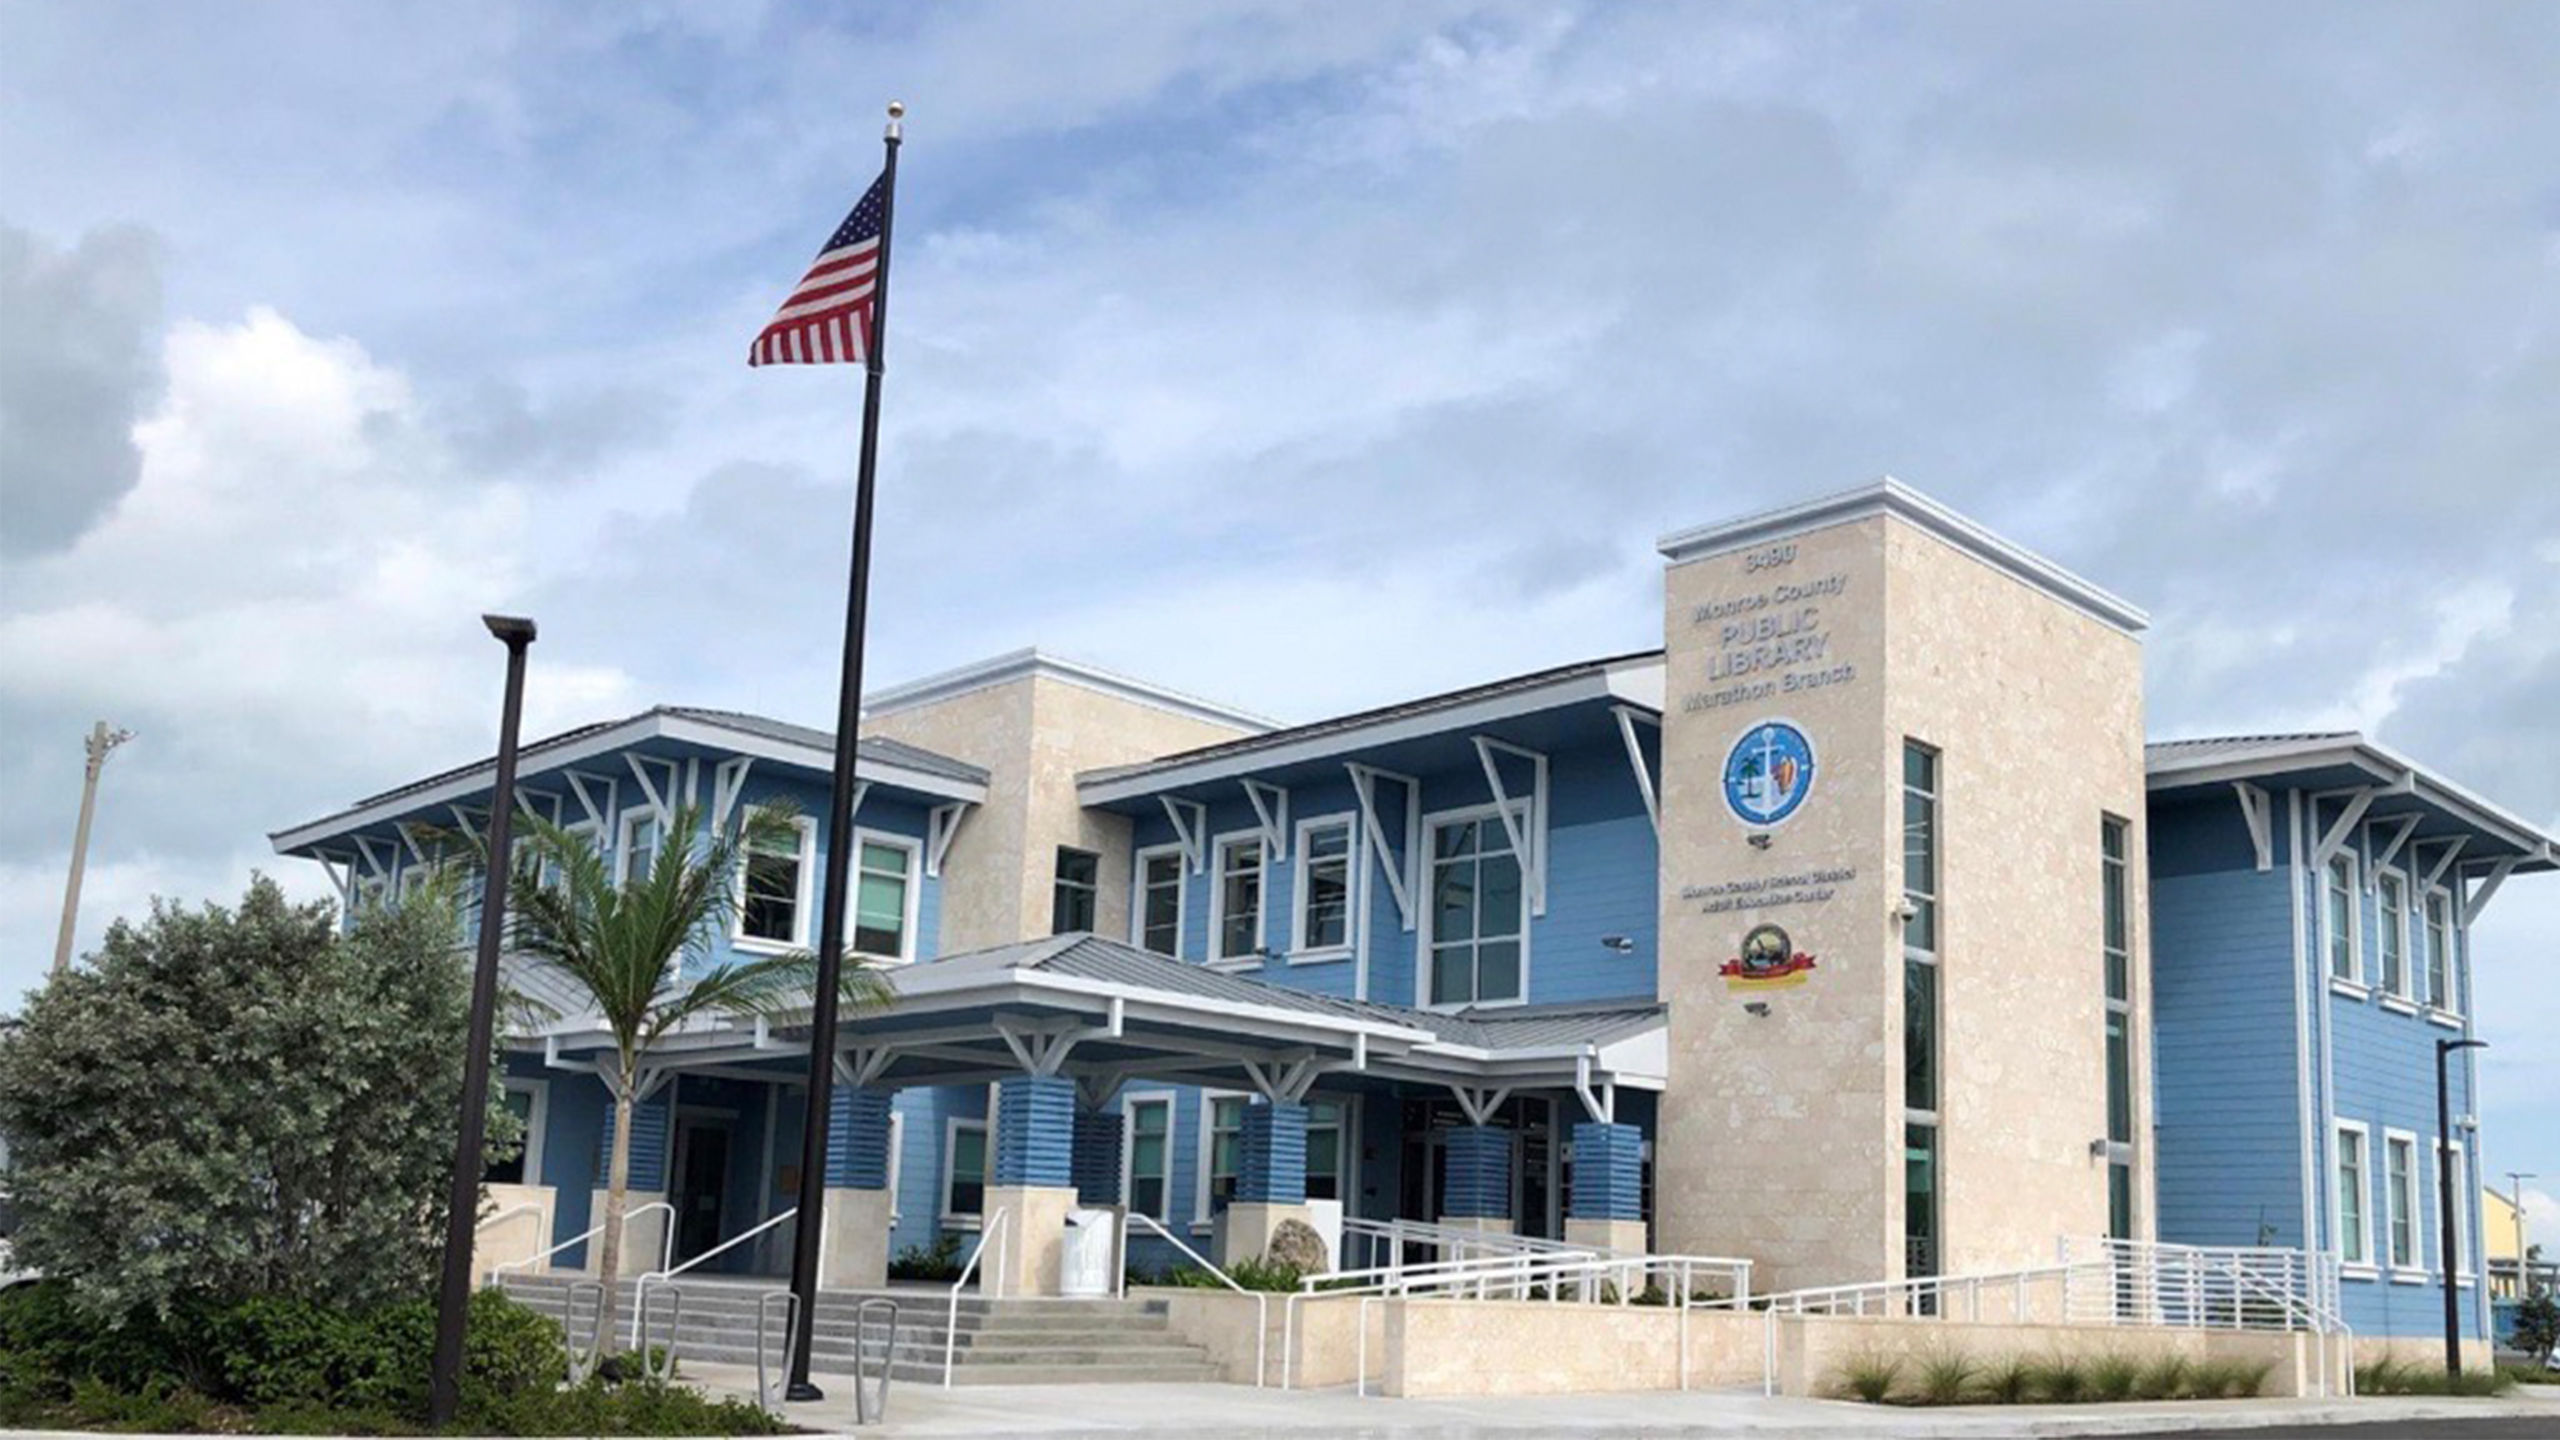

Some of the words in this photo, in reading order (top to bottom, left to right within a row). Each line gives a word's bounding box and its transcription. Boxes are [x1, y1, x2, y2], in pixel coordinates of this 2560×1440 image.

[1694, 593, 1769, 623] Monroe
[1773, 573, 1848, 604] County
[1720, 607, 1820, 649] PUBLIC
[1708, 632, 1830, 682] LIBRARY
[1681, 680, 1776, 713] Marathon
[1782, 662, 1856, 694] Branch
